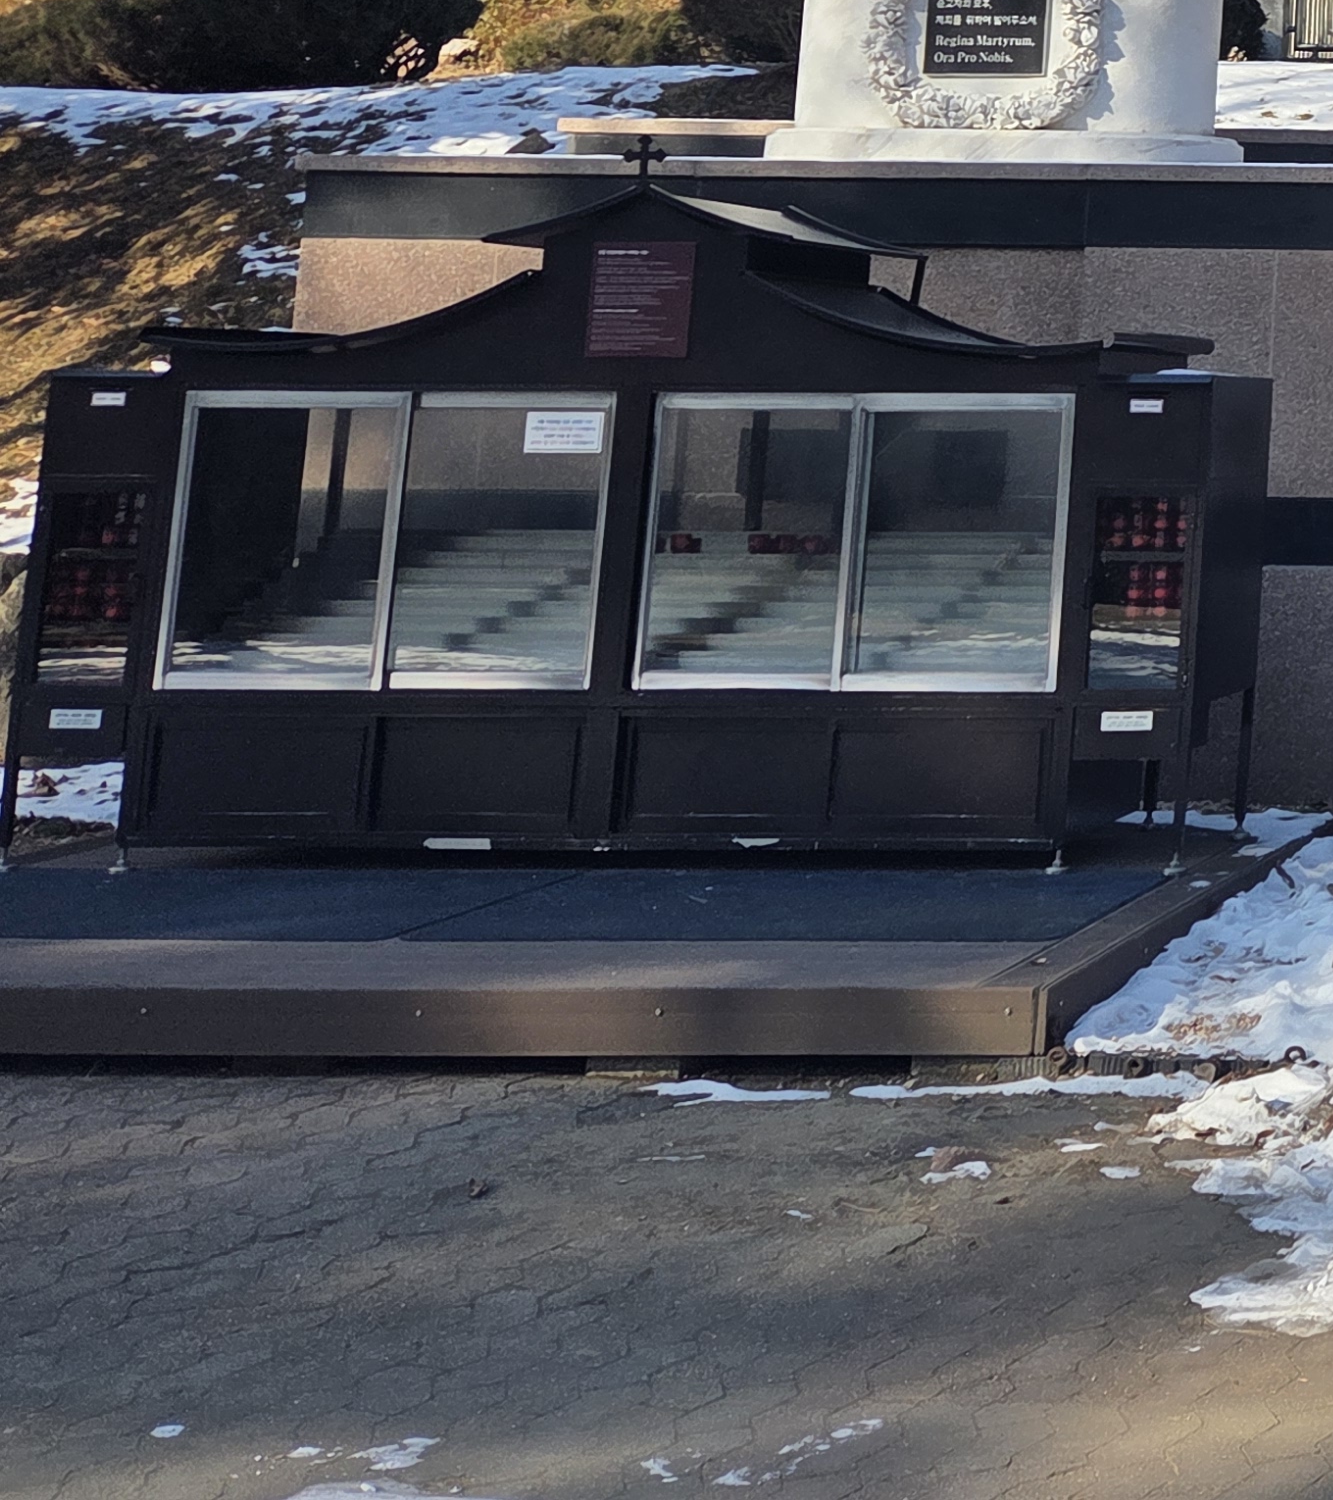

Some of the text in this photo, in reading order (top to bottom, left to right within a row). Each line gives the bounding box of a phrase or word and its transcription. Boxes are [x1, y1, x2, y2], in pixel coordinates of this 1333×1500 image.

[935, 34, 1036, 48] Regina Martyrum,
[933, 51, 1014, 63] Ora Pro Nobis.
